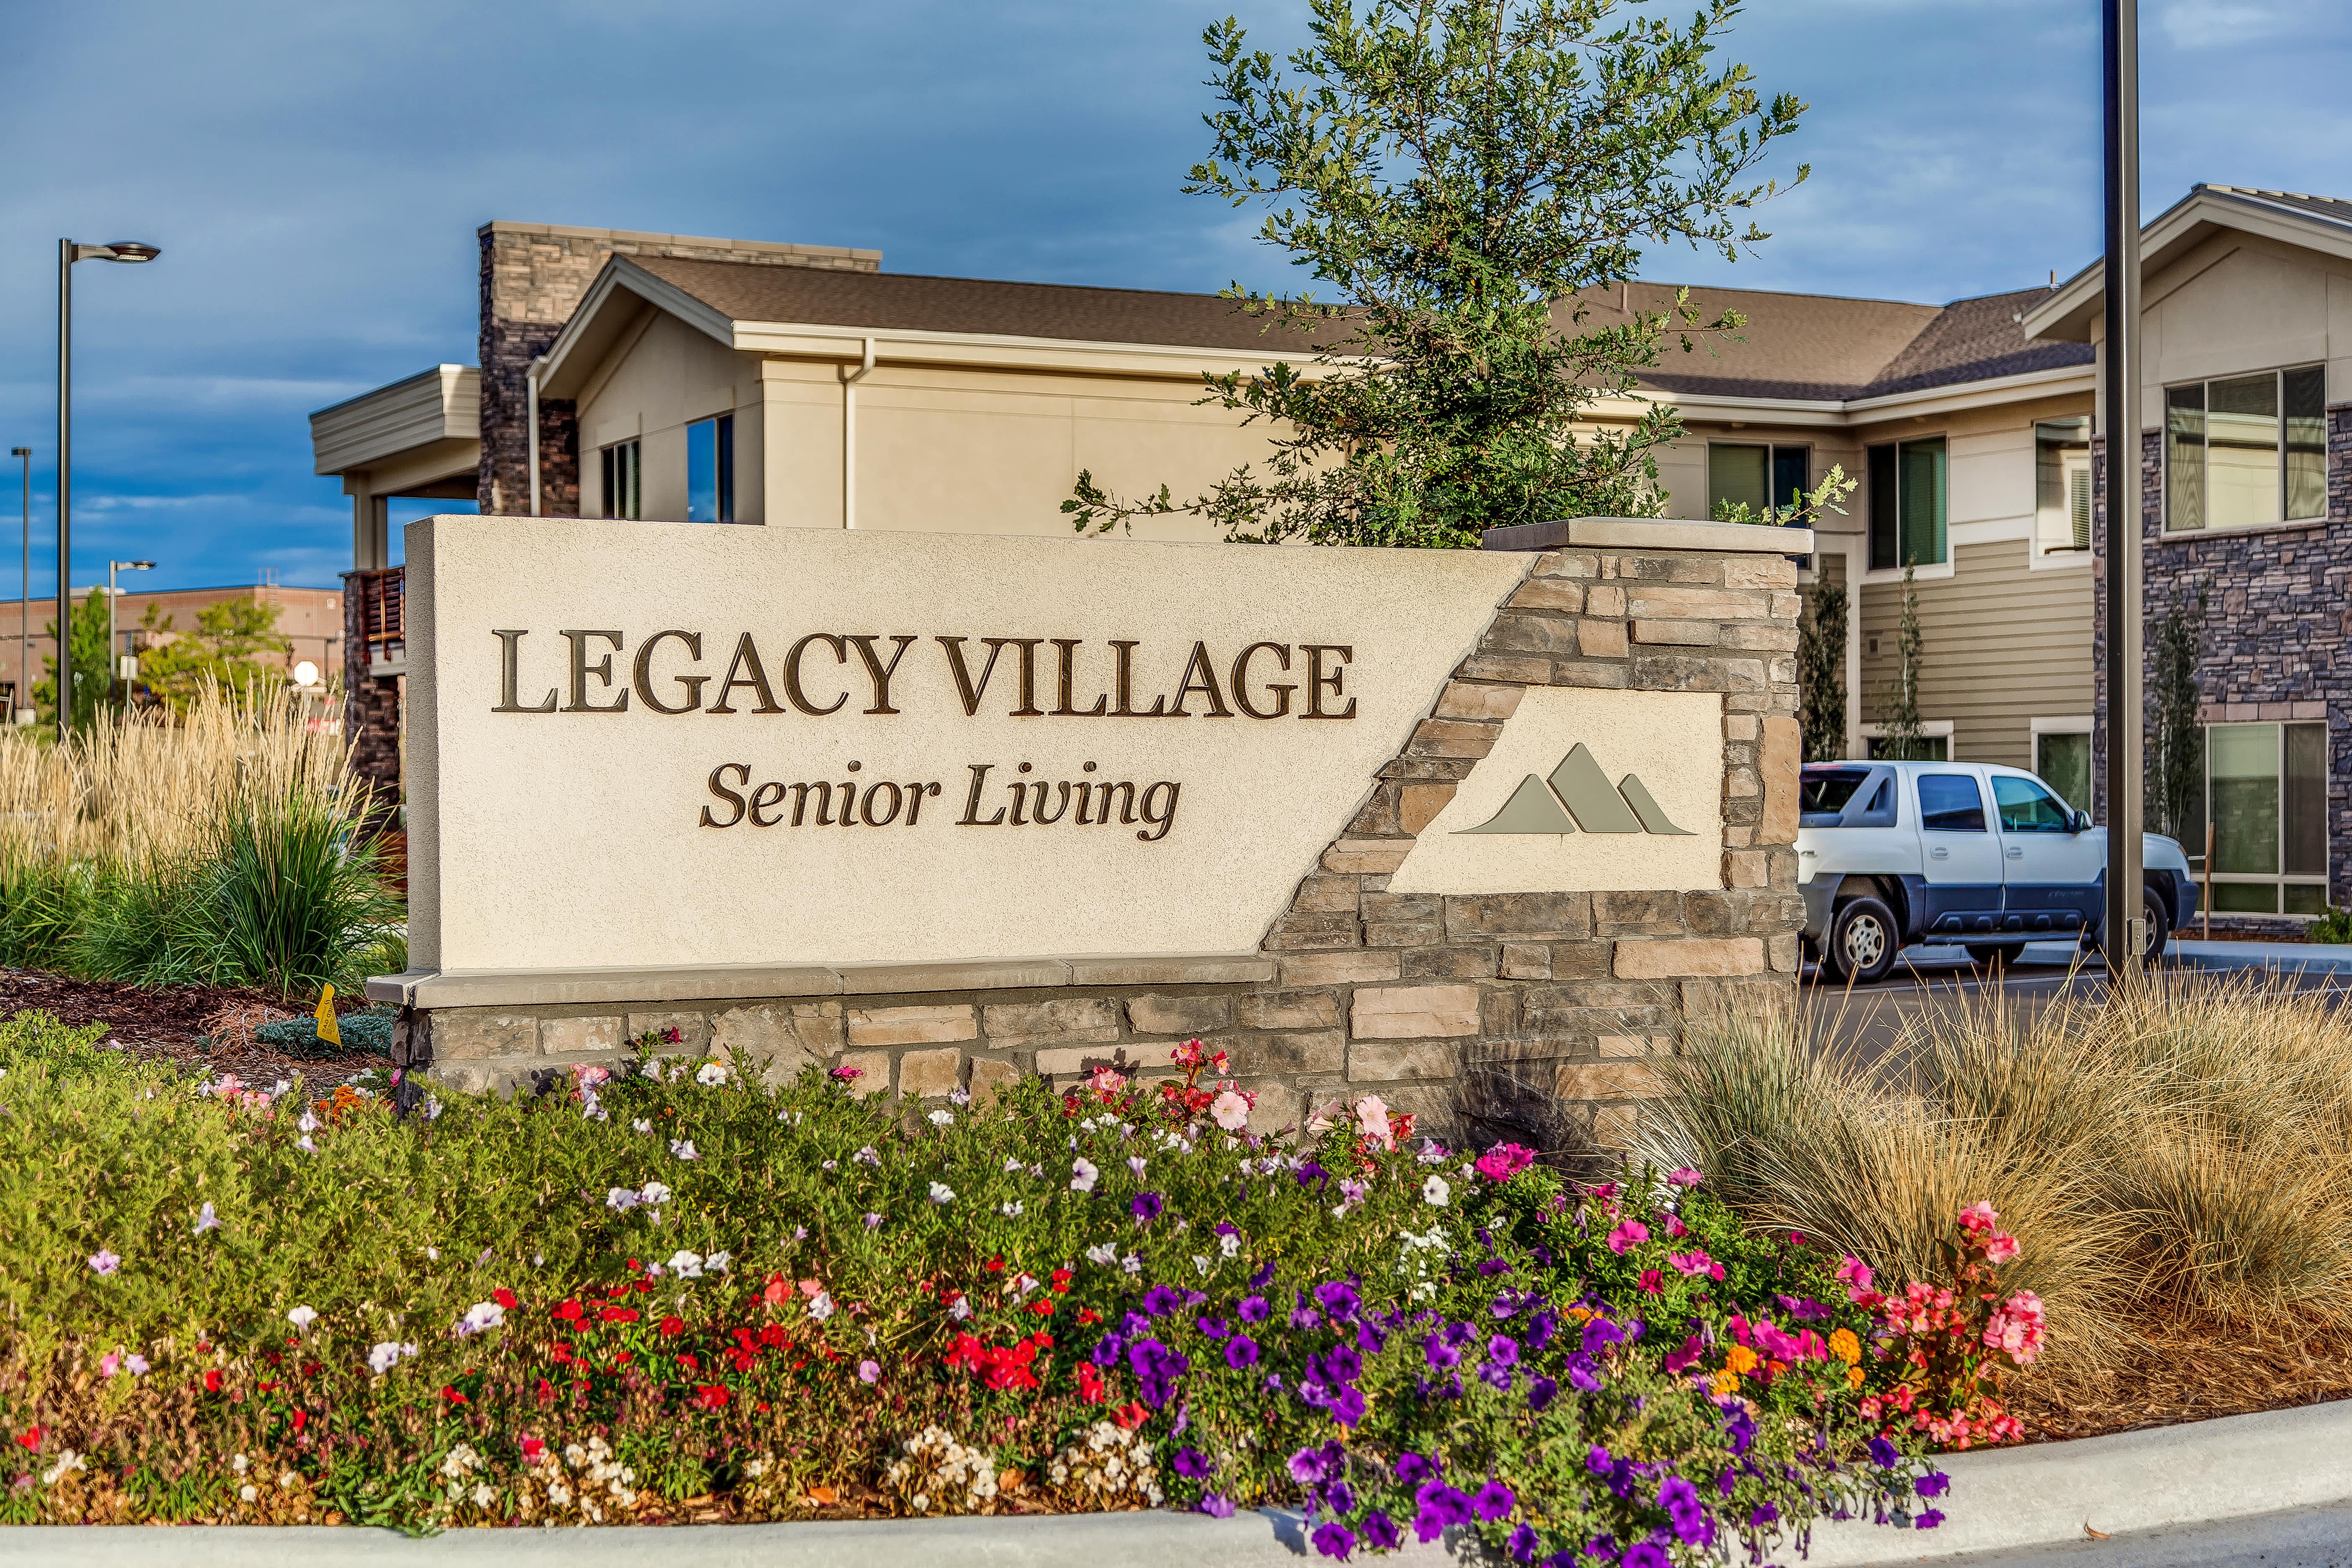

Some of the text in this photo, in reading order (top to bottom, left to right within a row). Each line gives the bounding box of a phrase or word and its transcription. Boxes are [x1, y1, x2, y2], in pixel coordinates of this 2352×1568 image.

[491, 629, 1357, 720] LEGACY VILLAGE
[698, 759, 1182, 843] Senior Living
